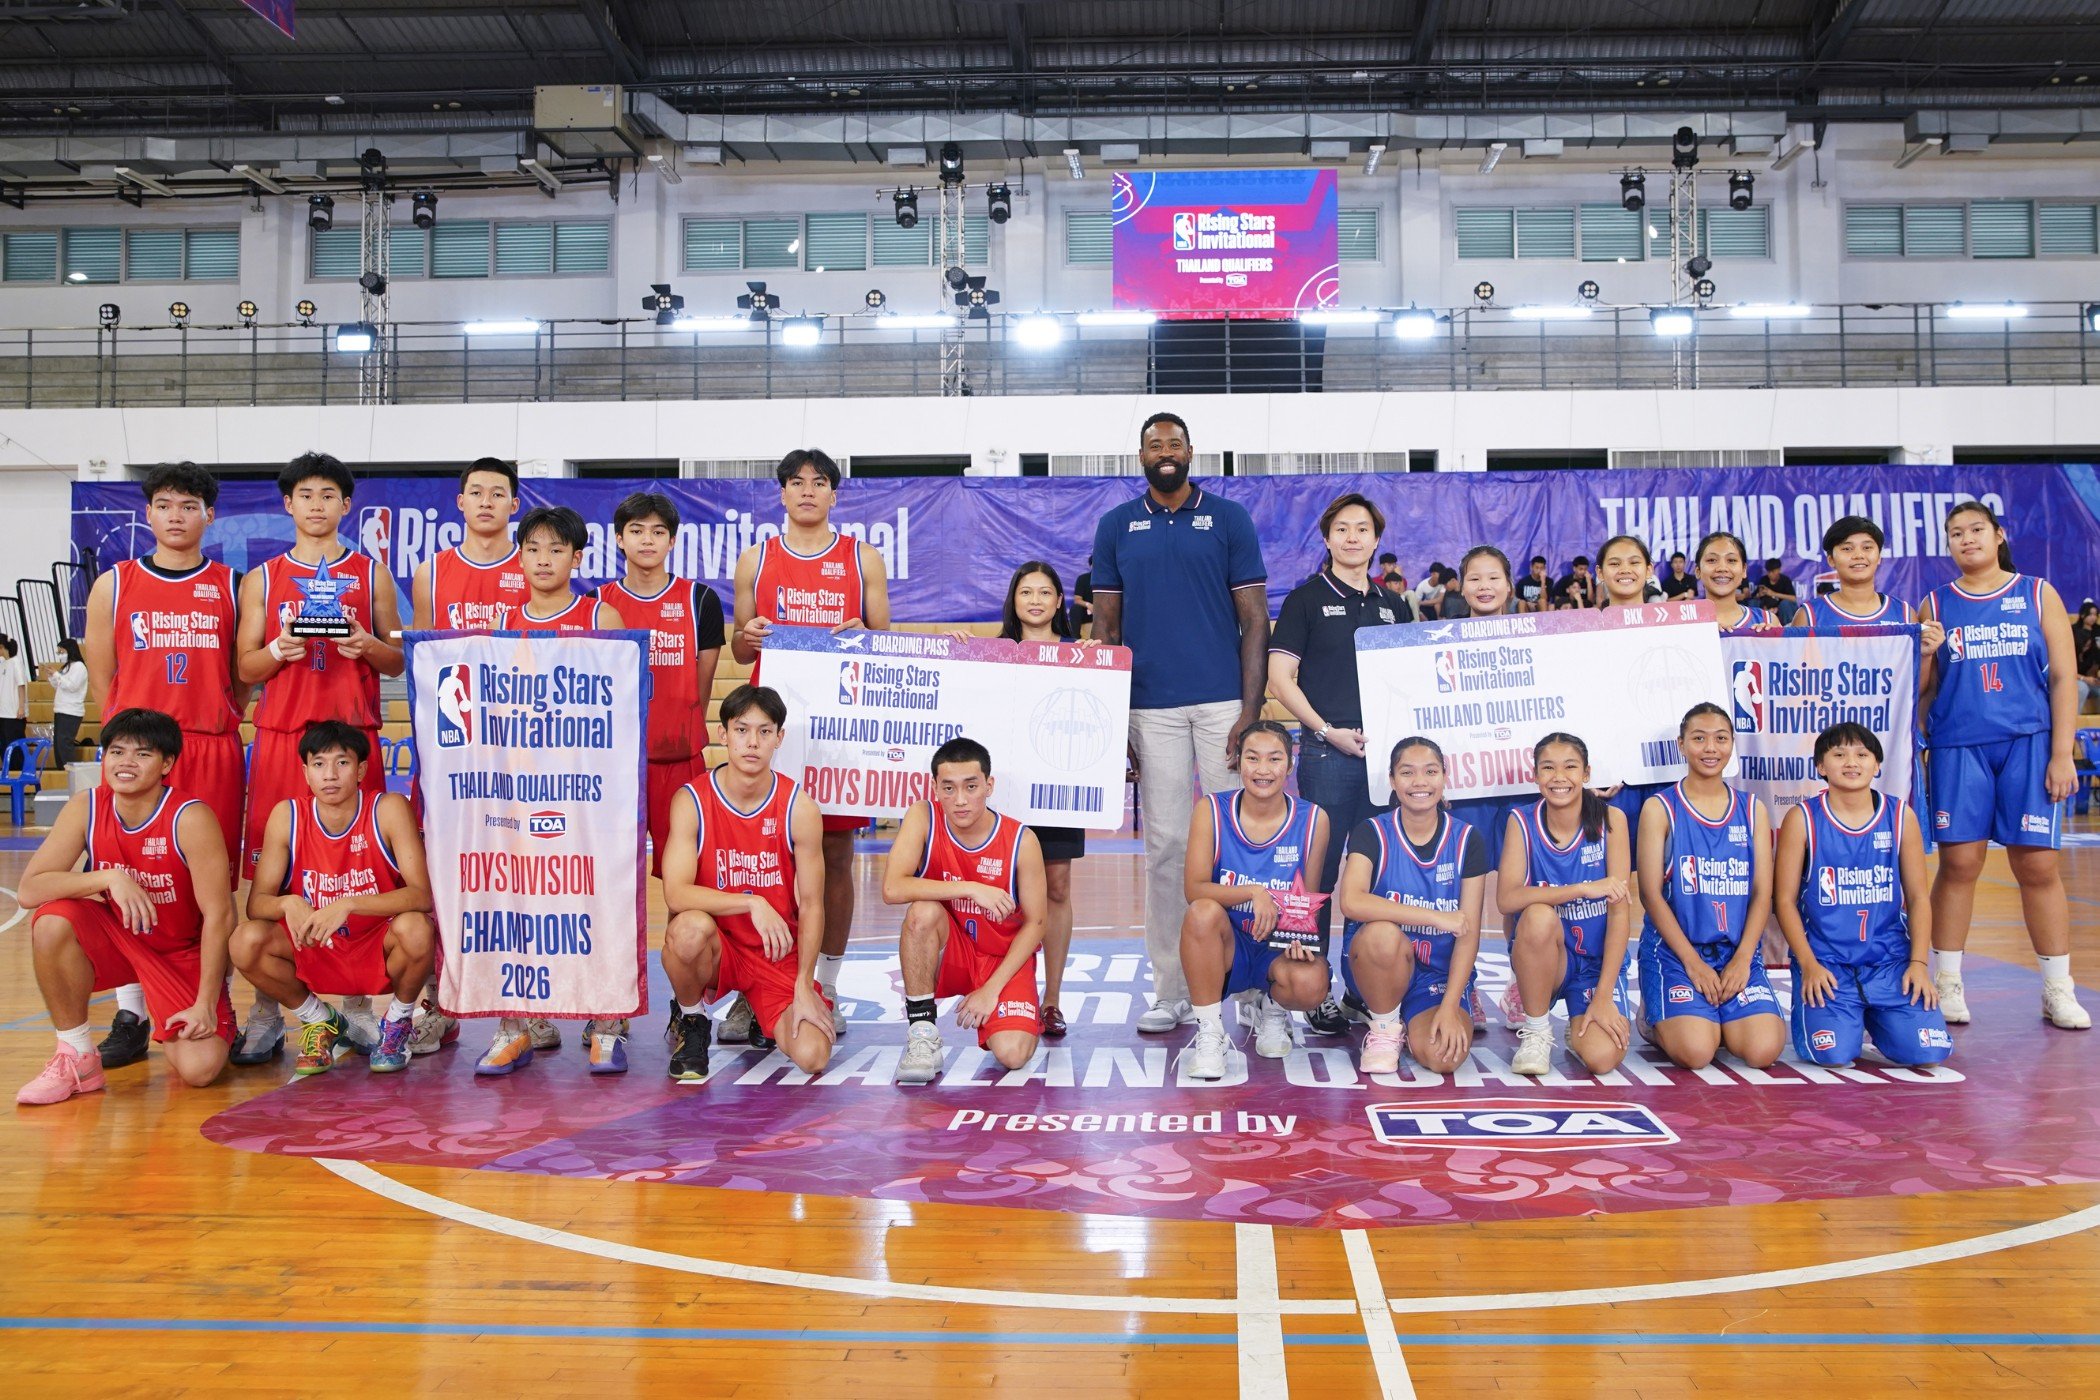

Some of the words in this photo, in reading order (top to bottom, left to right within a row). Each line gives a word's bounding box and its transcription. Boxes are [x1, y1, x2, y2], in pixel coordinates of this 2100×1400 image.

[1198, 213, 1238, 232] Rising
[1240, 213, 1275, 231] Stars
[1198, 231, 1274, 249] Invitational
[1176, 258, 1220, 272] THAILAND
[1221, 258, 1273, 272] QUALIFIERS
[500, 579, 525, 589] QUALIFIERS
[502, 572, 524, 581] THAILAND
[193, 590, 221, 600] QUALIFIERS
[787, 588, 817, 609] Rising
[818, 589, 845, 607] Stars
[465, 602, 494, 621] Rising
[787, 605, 844, 625] Invitational
[1623, 607, 1644, 626] BKK
[1680, 603, 1698, 621] SIN
[2001, 602, 2026, 611] QUALIFIERS
[152, 611, 189, 632] Rising
[191, 611, 219, 630] Stars
[1460, 619, 1511, 639] BOARDING
[1511, 617, 1537, 636] PASS
[1964, 624, 1998, 642] Rising
[1999, 622, 2028, 639] Stars
[152, 630, 220, 649] Invitational
[657, 631, 685, 648] Stars
[649, 649, 684, 666] ational
[872, 635, 923, 656] BOARDING
[924, 638, 950, 657] PASS
[1039, 645, 1060, 663] BKK
[1096, 648, 1113, 667] SIN
[1457, 646, 1497, 671] Rising
[1499, 645, 1533, 667] Stars
[165, 652, 188, 684] 12
[863, 662, 904, 689] Rising
[906, 665, 940, 687] Stars
[1459, 666, 1535, 692] Invitational
[1980, 662, 2003, 693] 14
[480, 663, 548, 713] Rising
[553, 665, 613, 707] Stars
[1769, 662, 1833, 702] Rising
[1838, 661, 1893, 696] Stars
[862, 685, 939, 710] Invitational
[1413, 702, 1483, 731] THAILAND
[1486, 696, 1566, 725] QUALIFIERS
[1736, 717, 1752, 730] NBA
[441, 729, 461, 744] NBA
[480, 706, 613, 749] Invitational
[810, 716, 879, 743] THAILAND
[887, 751, 905, 759] TOA
[1480, 747, 1536, 787] DIVIS
[1740, 756, 1804, 780] THAILAND
[448, 771, 514, 801] THAILAND
[517, 773, 603, 803] QUALIFIERS
[803, 765, 861, 807] BOYS
[864, 769, 936, 808] DIVISI
[485, 813, 512, 829] Presented
[512, 815, 521, 832] by
[531, 818, 564, 832] TOA
[142, 845, 168, 856] QUALIFIERS
[1273, 854, 1299, 863] QUALIFIERS
[1275, 846, 1298, 855] THAILAND
[976, 864, 1003, 876] QUALIFIERS
[981, 856, 1003, 868] THAILAND
[140, 871, 174, 888] Stars
[319, 871, 349, 892] Rising
[350, 868, 376, 888] Stars
[460, 852, 508, 893] BOYS
[511, 854, 595, 896] DIVISION
[1837, 866, 1873, 888] Rising
[461, 910, 592, 956] CHAMPIONS
[965, 919, 978, 943] 9
[1857, 910, 1868, 941] 7
[1571, 926, 1587, 955] 2
[501, 962, 551, 1000] 2026
[1670, 990, 1692, 998] TOA
[1814, 1035, 1834, 1046] TOA
[676, 1044, 1249, 1088] THALAND
[946, 1109, 1221, 1133] Presented
[1237, 1110, 1297, 1137] by
[1387, 1111, 1652, 1135] TOA
